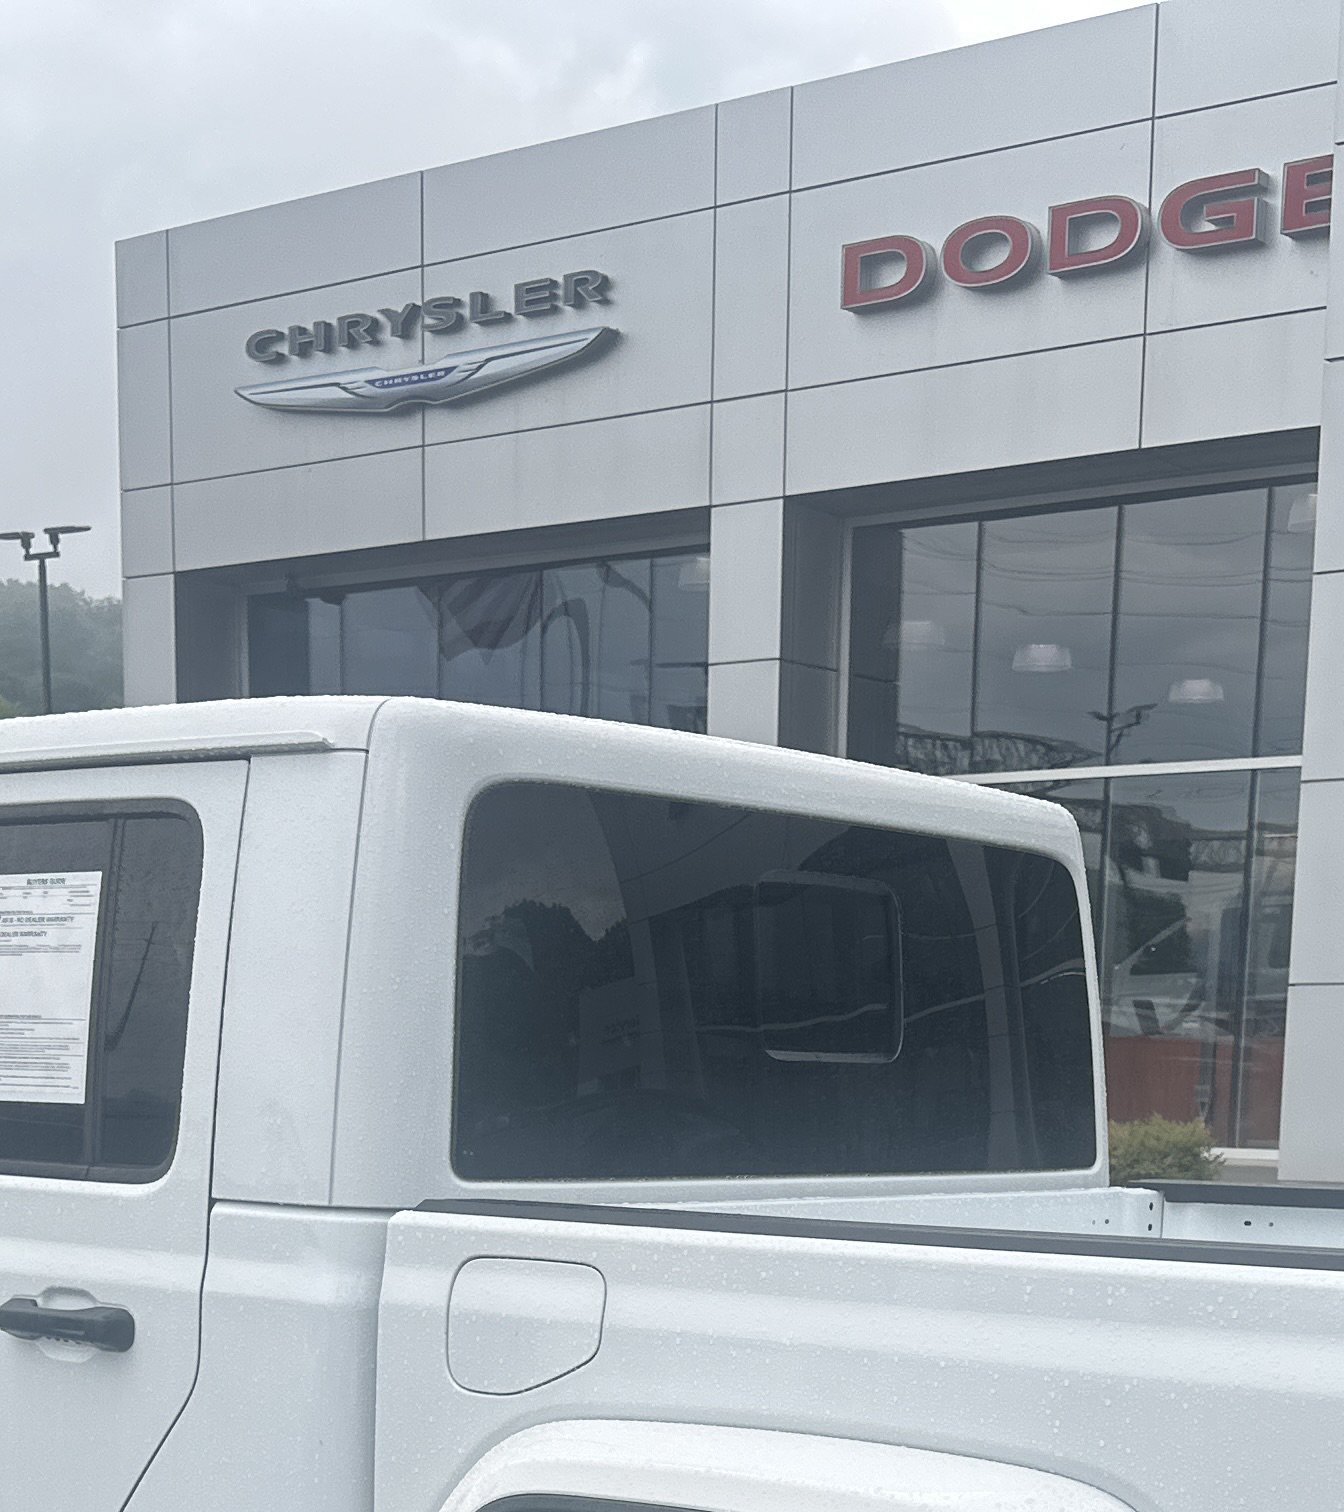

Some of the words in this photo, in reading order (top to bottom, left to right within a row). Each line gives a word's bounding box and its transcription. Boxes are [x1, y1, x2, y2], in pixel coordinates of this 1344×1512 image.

[840, 154, 1335, 312] DODGE
[245, 269, 612, 363] CHRYSLER
[374, 369, 446, 388] CHRYSLER
